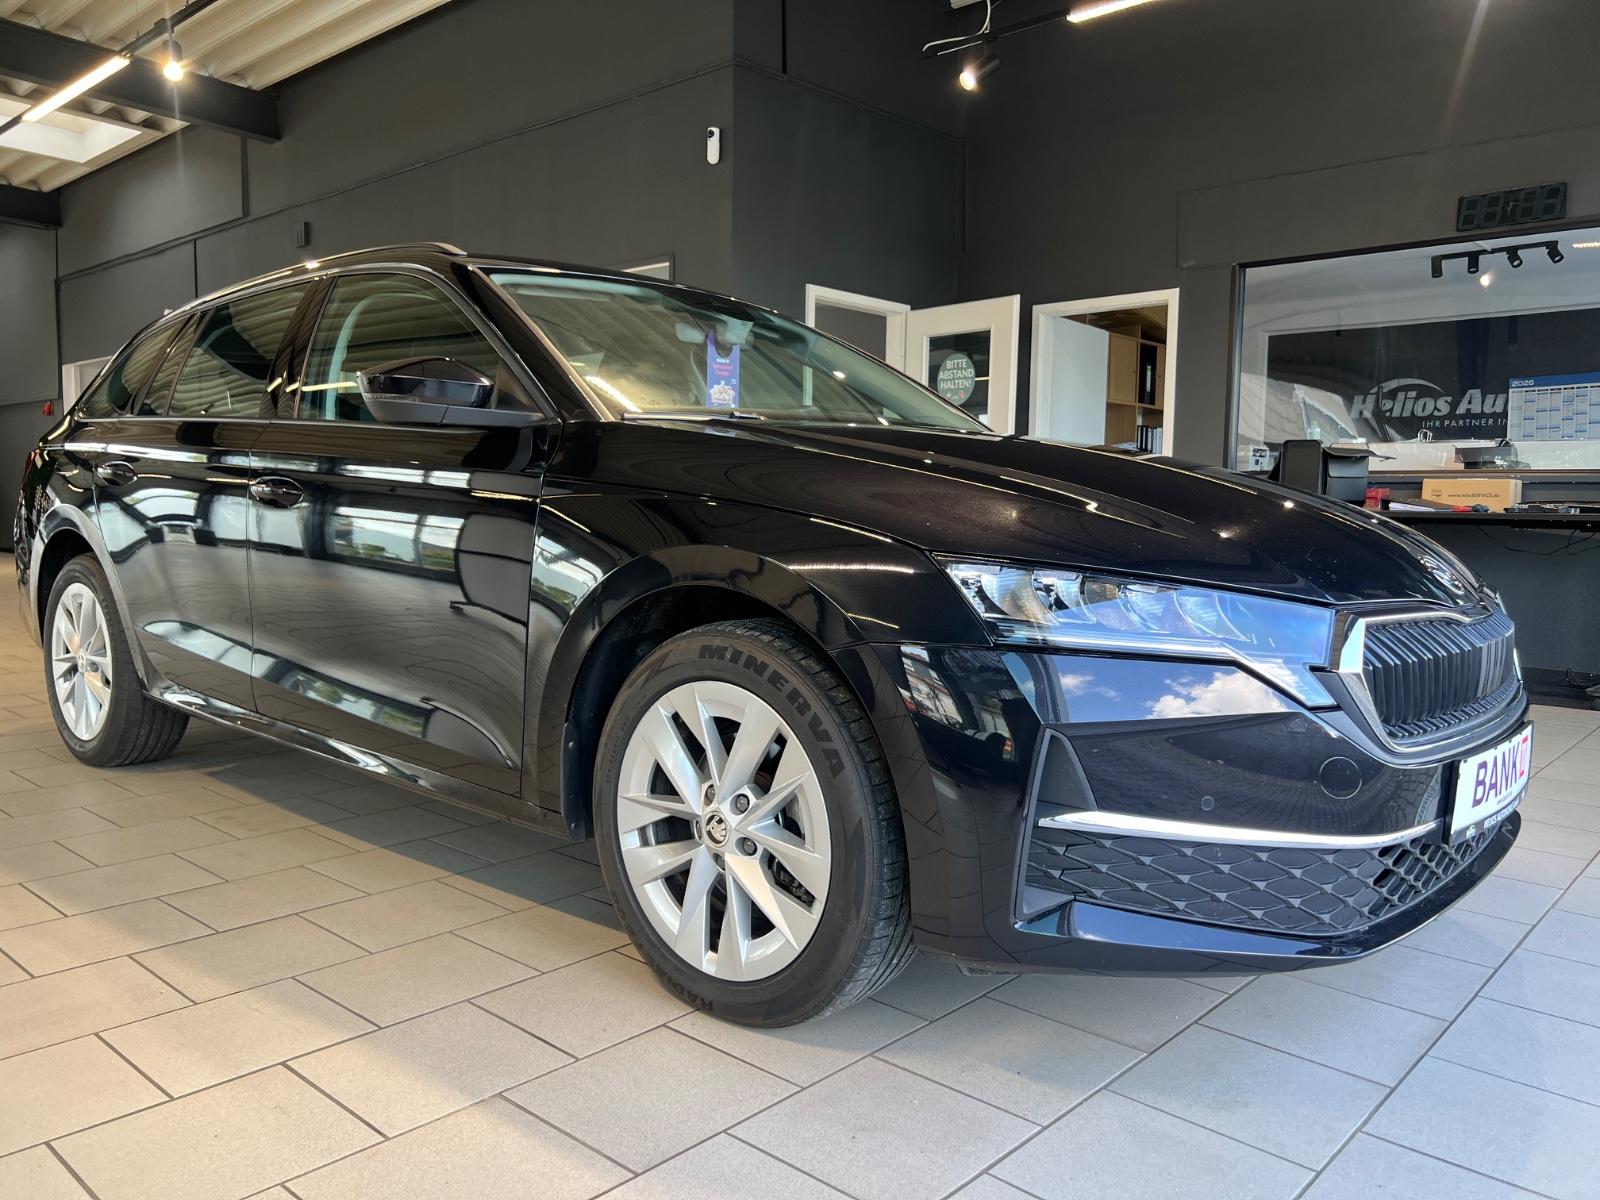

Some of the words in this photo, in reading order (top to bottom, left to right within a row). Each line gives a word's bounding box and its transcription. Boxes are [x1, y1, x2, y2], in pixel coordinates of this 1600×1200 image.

[946, 359, 968, 370] BITTE
[939, 368, 974, 380] ABSTAND
[940, 379, 972, 390] HALTEN!
[1349, 390, 1453, 419] Helios
[1456, 388, 1509, 415] Au
[1422, 420, 1441, 428] IHR
[1444, 418, 1494, 428] PARTNER
[699, 644, 845, 778] MINERVA
